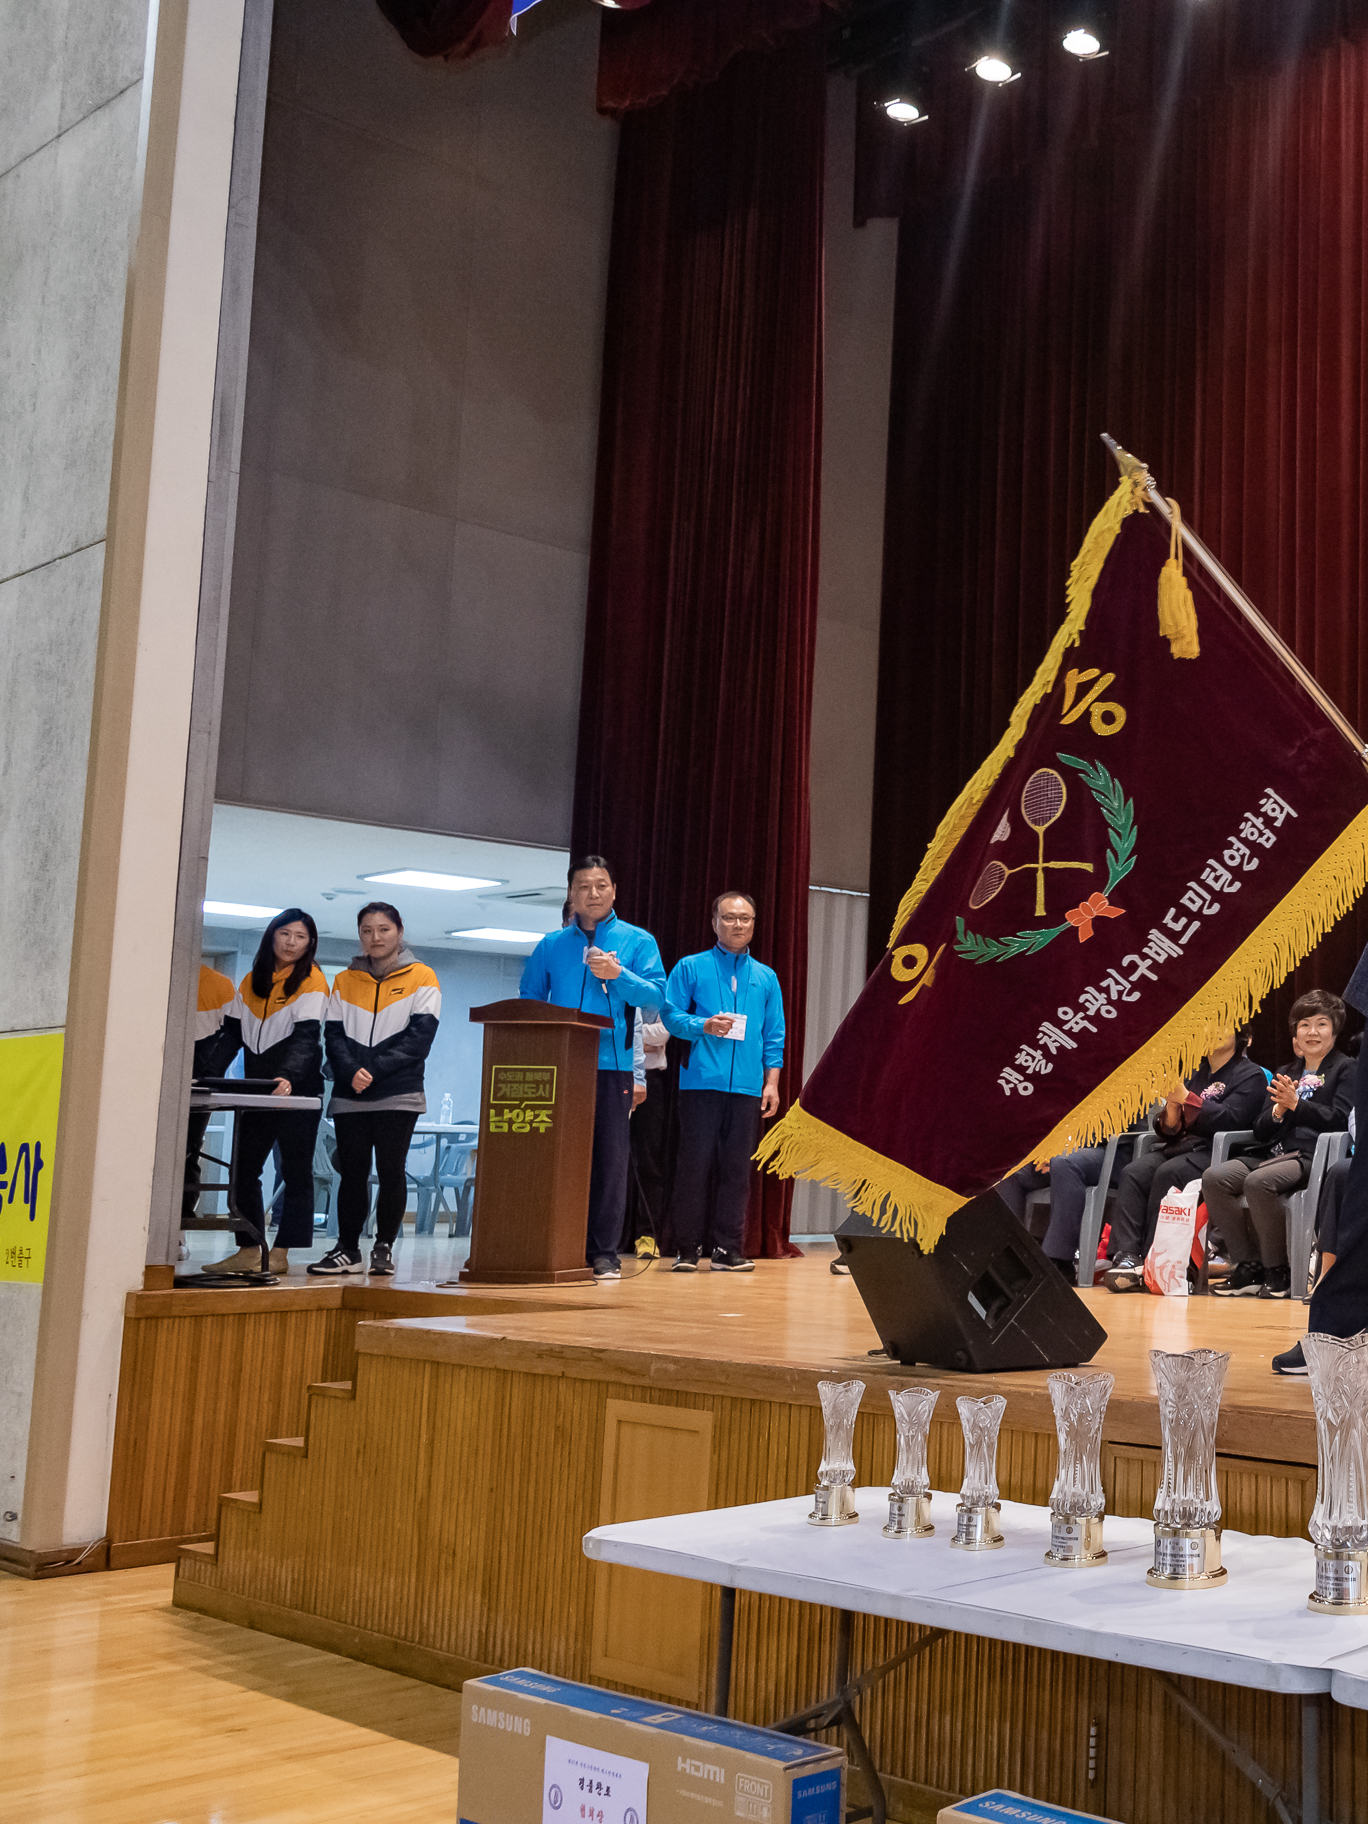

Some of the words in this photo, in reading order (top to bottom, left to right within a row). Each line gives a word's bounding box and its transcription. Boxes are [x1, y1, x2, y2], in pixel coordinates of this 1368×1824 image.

[997, 787, 1298, 1096] 생활체육광진구배드민턴연합회
[497, 1083, 550, 1098] 거점도시
[489, 1108, 554, 1133] 남양주
[0, 1140, 44, 1222] 사
[471, 1704, 532, 1737] SAMSUNG
[677, 1756, 725, 1784] HDMI
[738, 1777, 770, 1799] FRONT
[797, 1780, 838, 1799] SAMSUNG
